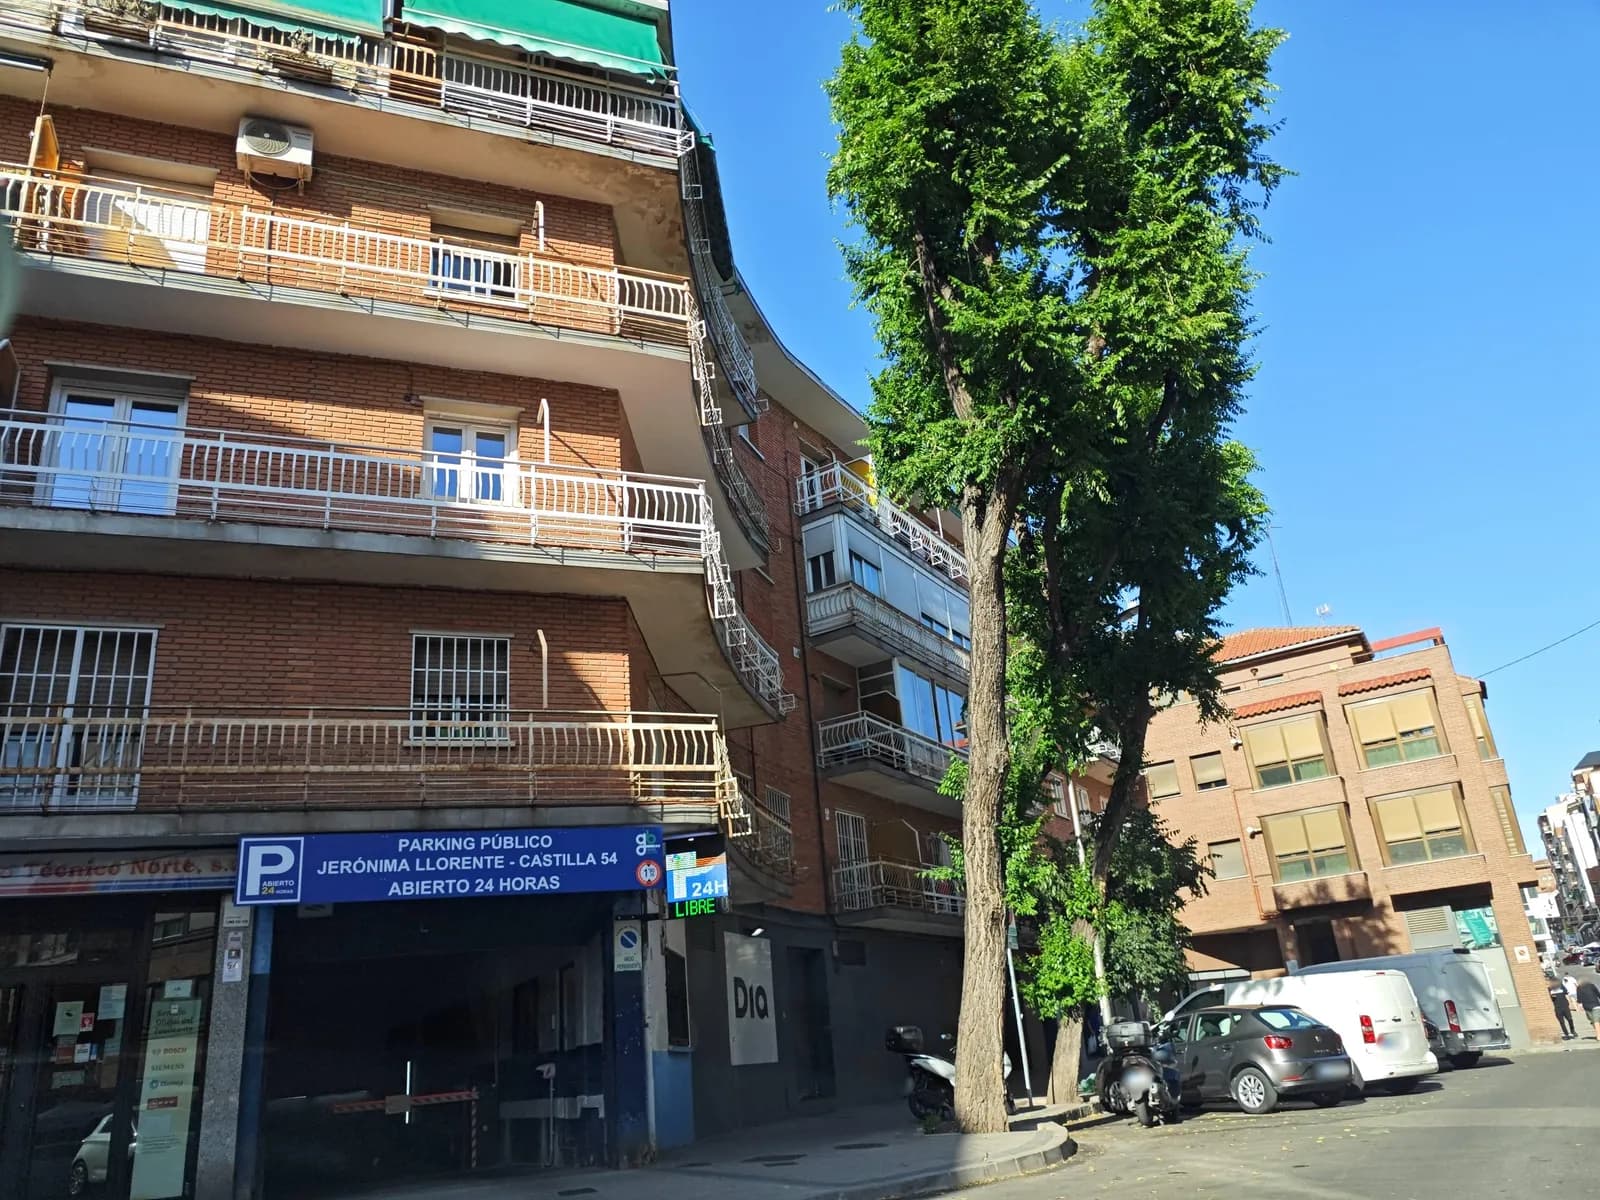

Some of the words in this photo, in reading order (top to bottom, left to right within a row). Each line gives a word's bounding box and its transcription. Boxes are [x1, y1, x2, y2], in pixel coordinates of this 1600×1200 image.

[398, 836, 475, 852] PARKING
[480, 834, 552, 850] PÚBLICO
[245, 845, 295, 896] P
[317, 857, 410, 875] JERÓNIMA
[415, 856, 505, 872] LLORENTE
[519, 853, 597, 868] CASTILLA
[600, 852, 618, 865] 54
[261, 887, 275, 895] 24
[262, 879, 295, 887] ABIERTO
[388, 879, 470, 896] ABIERTO
[474, 878, 495, 892] 24
[499, 875, 560, 891] HORAS
[692, 880, 727, 897] 24H
[675, 898, 716, 918] LIBRE
